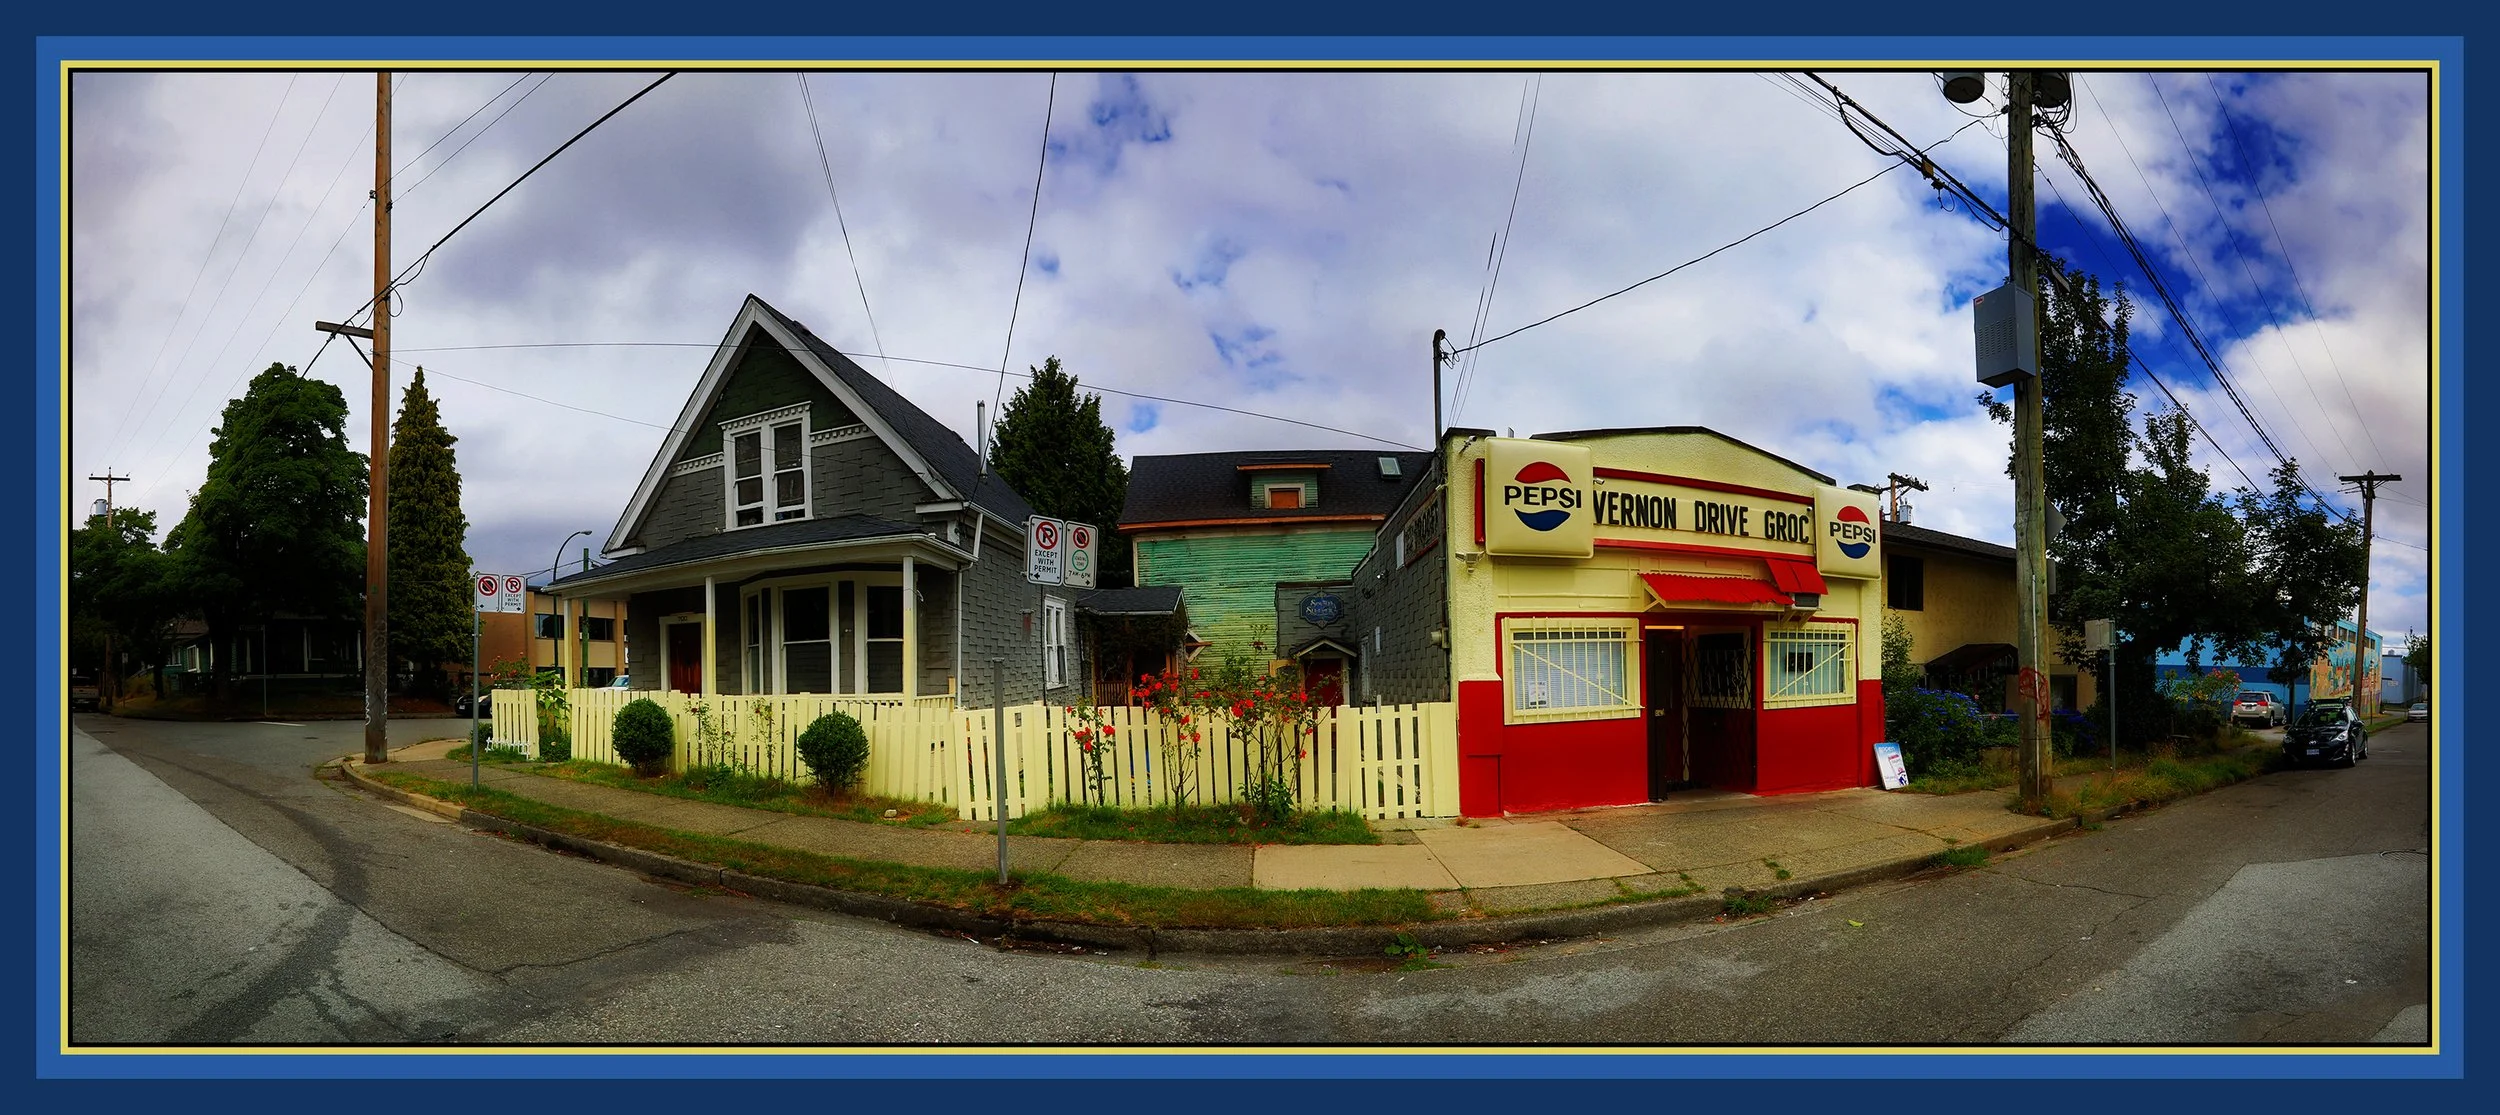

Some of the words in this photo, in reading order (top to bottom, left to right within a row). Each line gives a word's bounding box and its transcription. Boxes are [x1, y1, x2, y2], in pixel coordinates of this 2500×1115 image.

[1504, 485, 1582, 509] PEPSI
[1593, 489, 1677, 530] VERNON
[1694, 500, 1750, 537] DRIVE
[1764, 509, 1810, 544] GROC
[1829, 521, 1877, 544] PEPSI
[1034, 549, 1058, 559] EXCEPT
[1038, 557, 1055, 566] WITH
[1034, 564, 1057, 574] PERMIT
